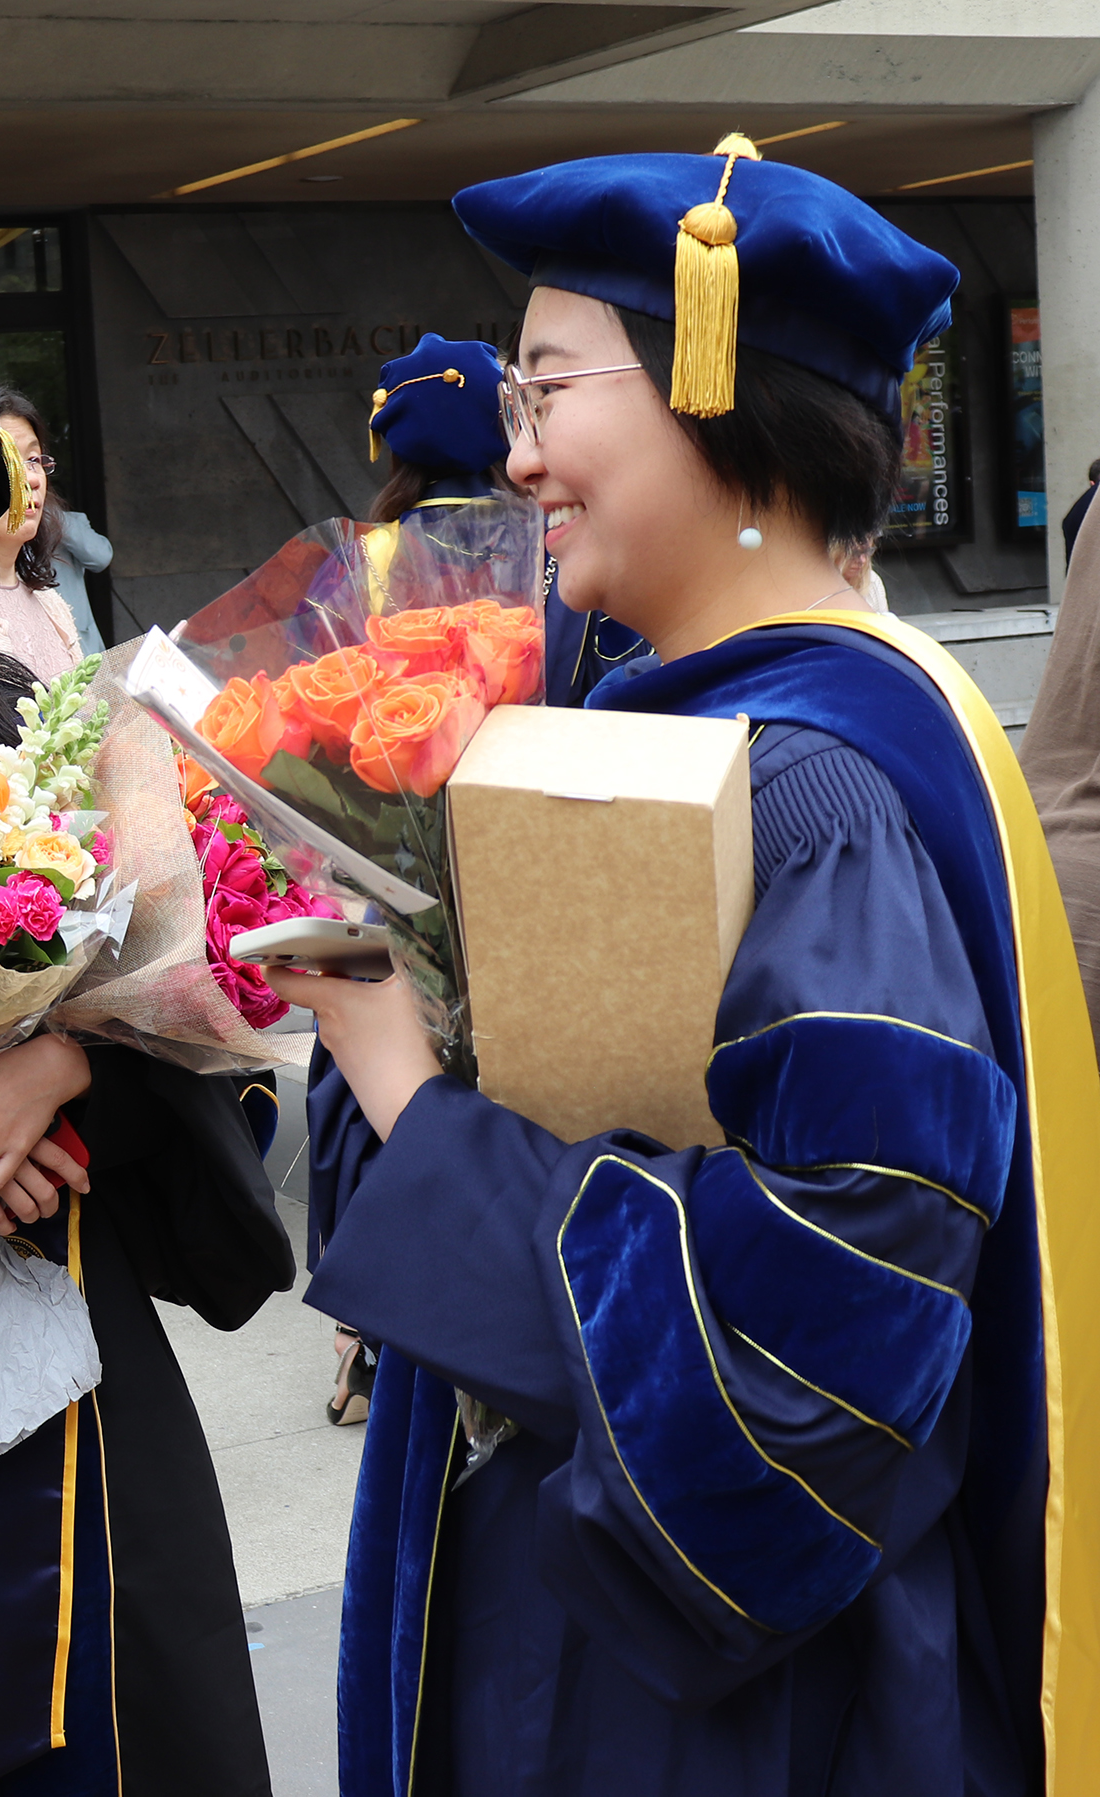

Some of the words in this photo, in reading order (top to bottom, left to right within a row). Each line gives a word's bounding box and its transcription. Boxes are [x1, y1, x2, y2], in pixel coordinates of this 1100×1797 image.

[147, 324, 422, 366] ZELLERBACH
[221, 367, 354, 382] AUDITORIUM
[929, 362, 949, 525] Performances
[907, 502, 927, 512] NOW
